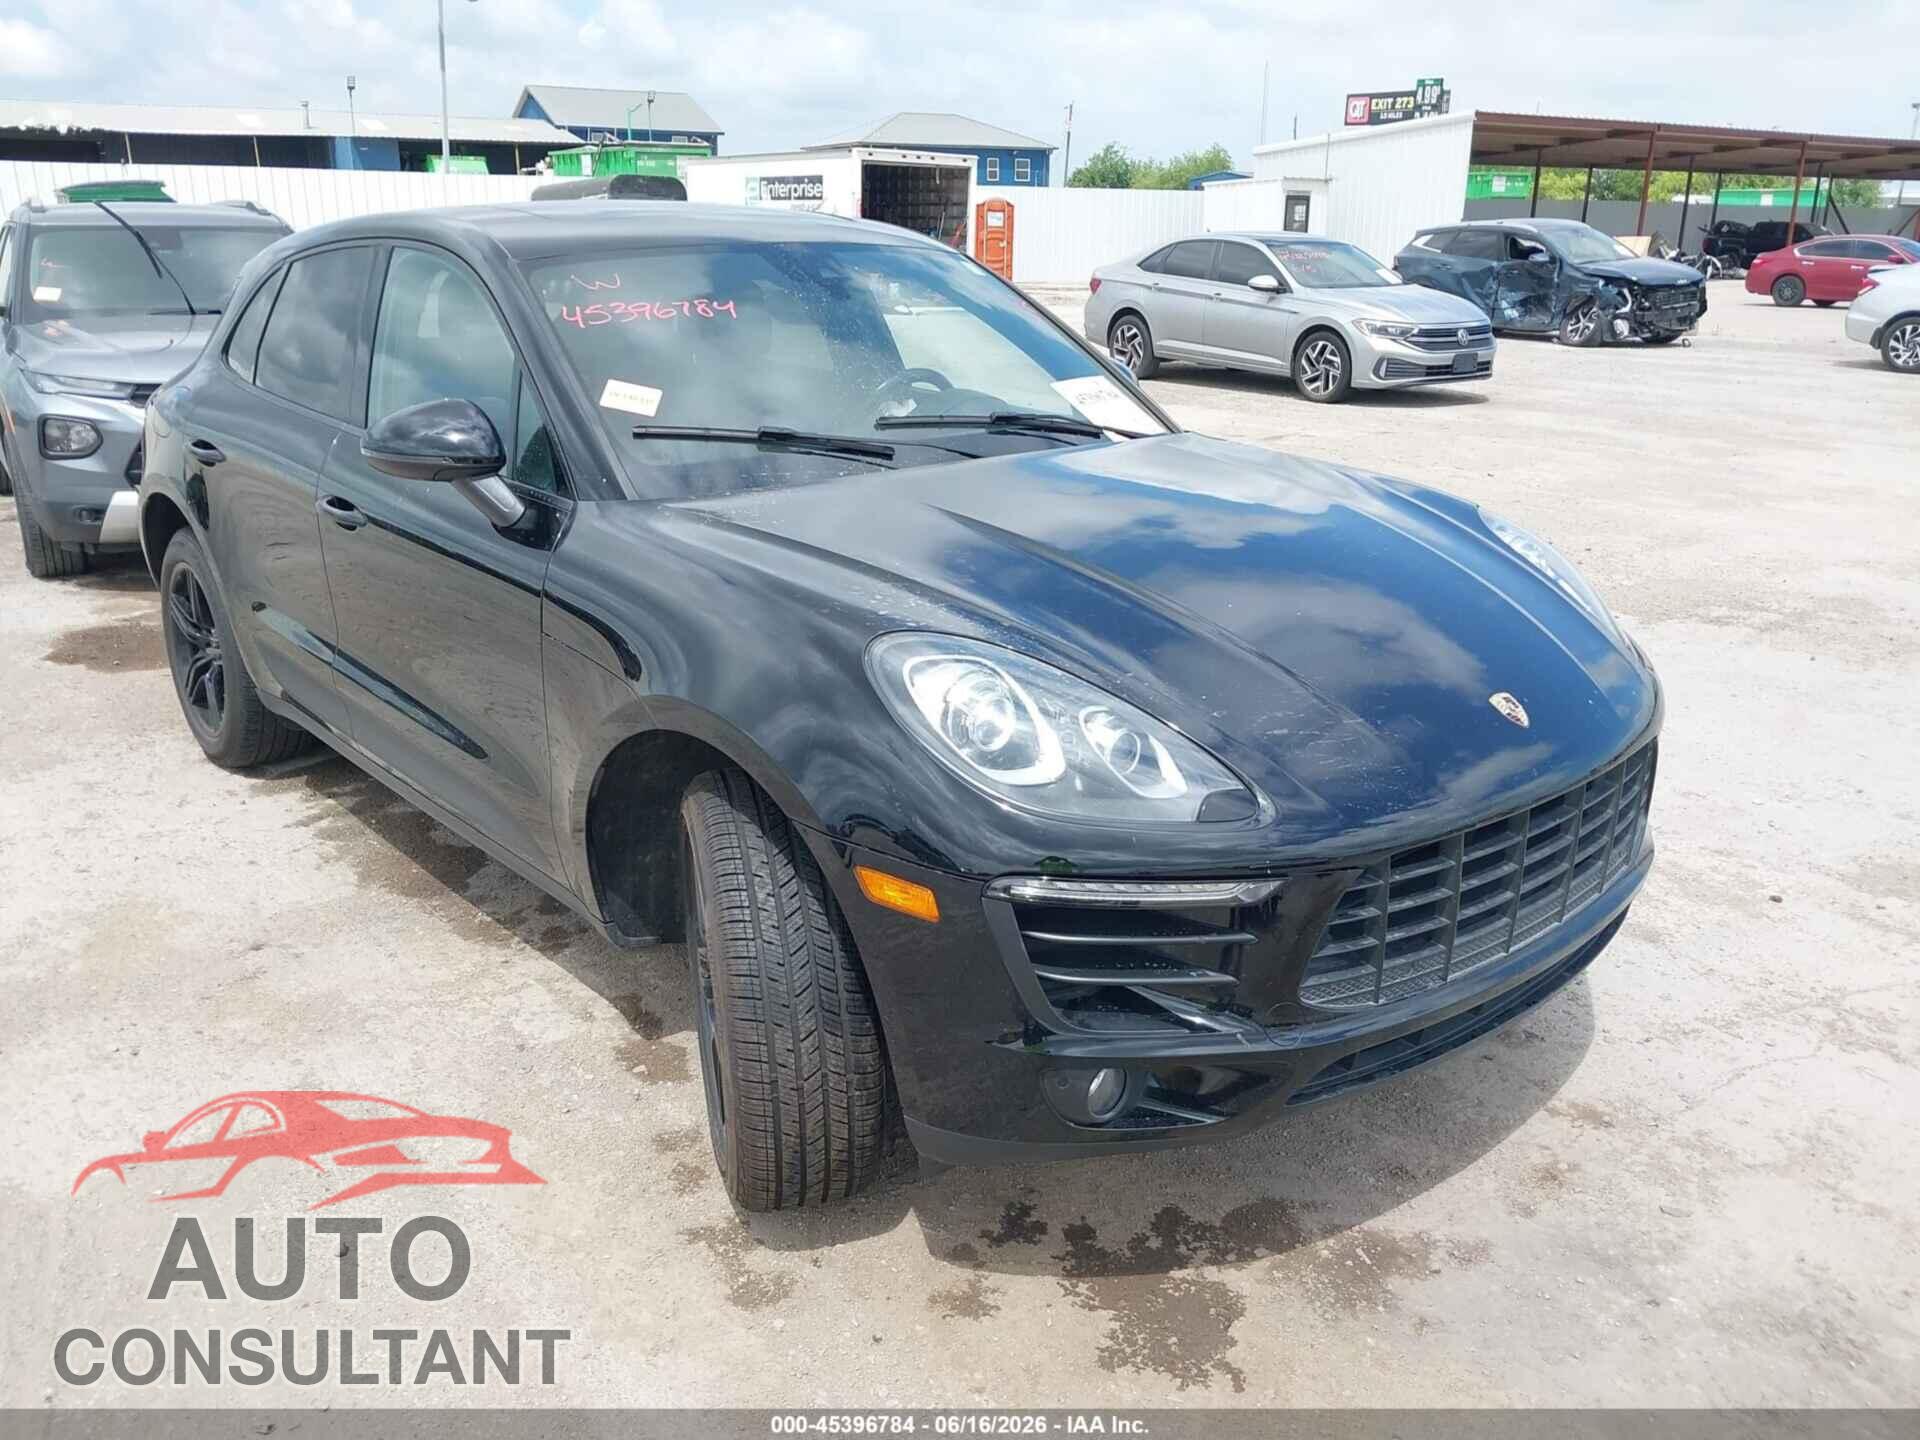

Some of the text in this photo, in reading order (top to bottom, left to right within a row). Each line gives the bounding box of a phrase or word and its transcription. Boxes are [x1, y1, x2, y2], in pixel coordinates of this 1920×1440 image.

[1371, 96, 1415, 110] EXIT 273
[760, 177, 822, 200] Enterprise
[562, 299, 737, 328] 45396784
